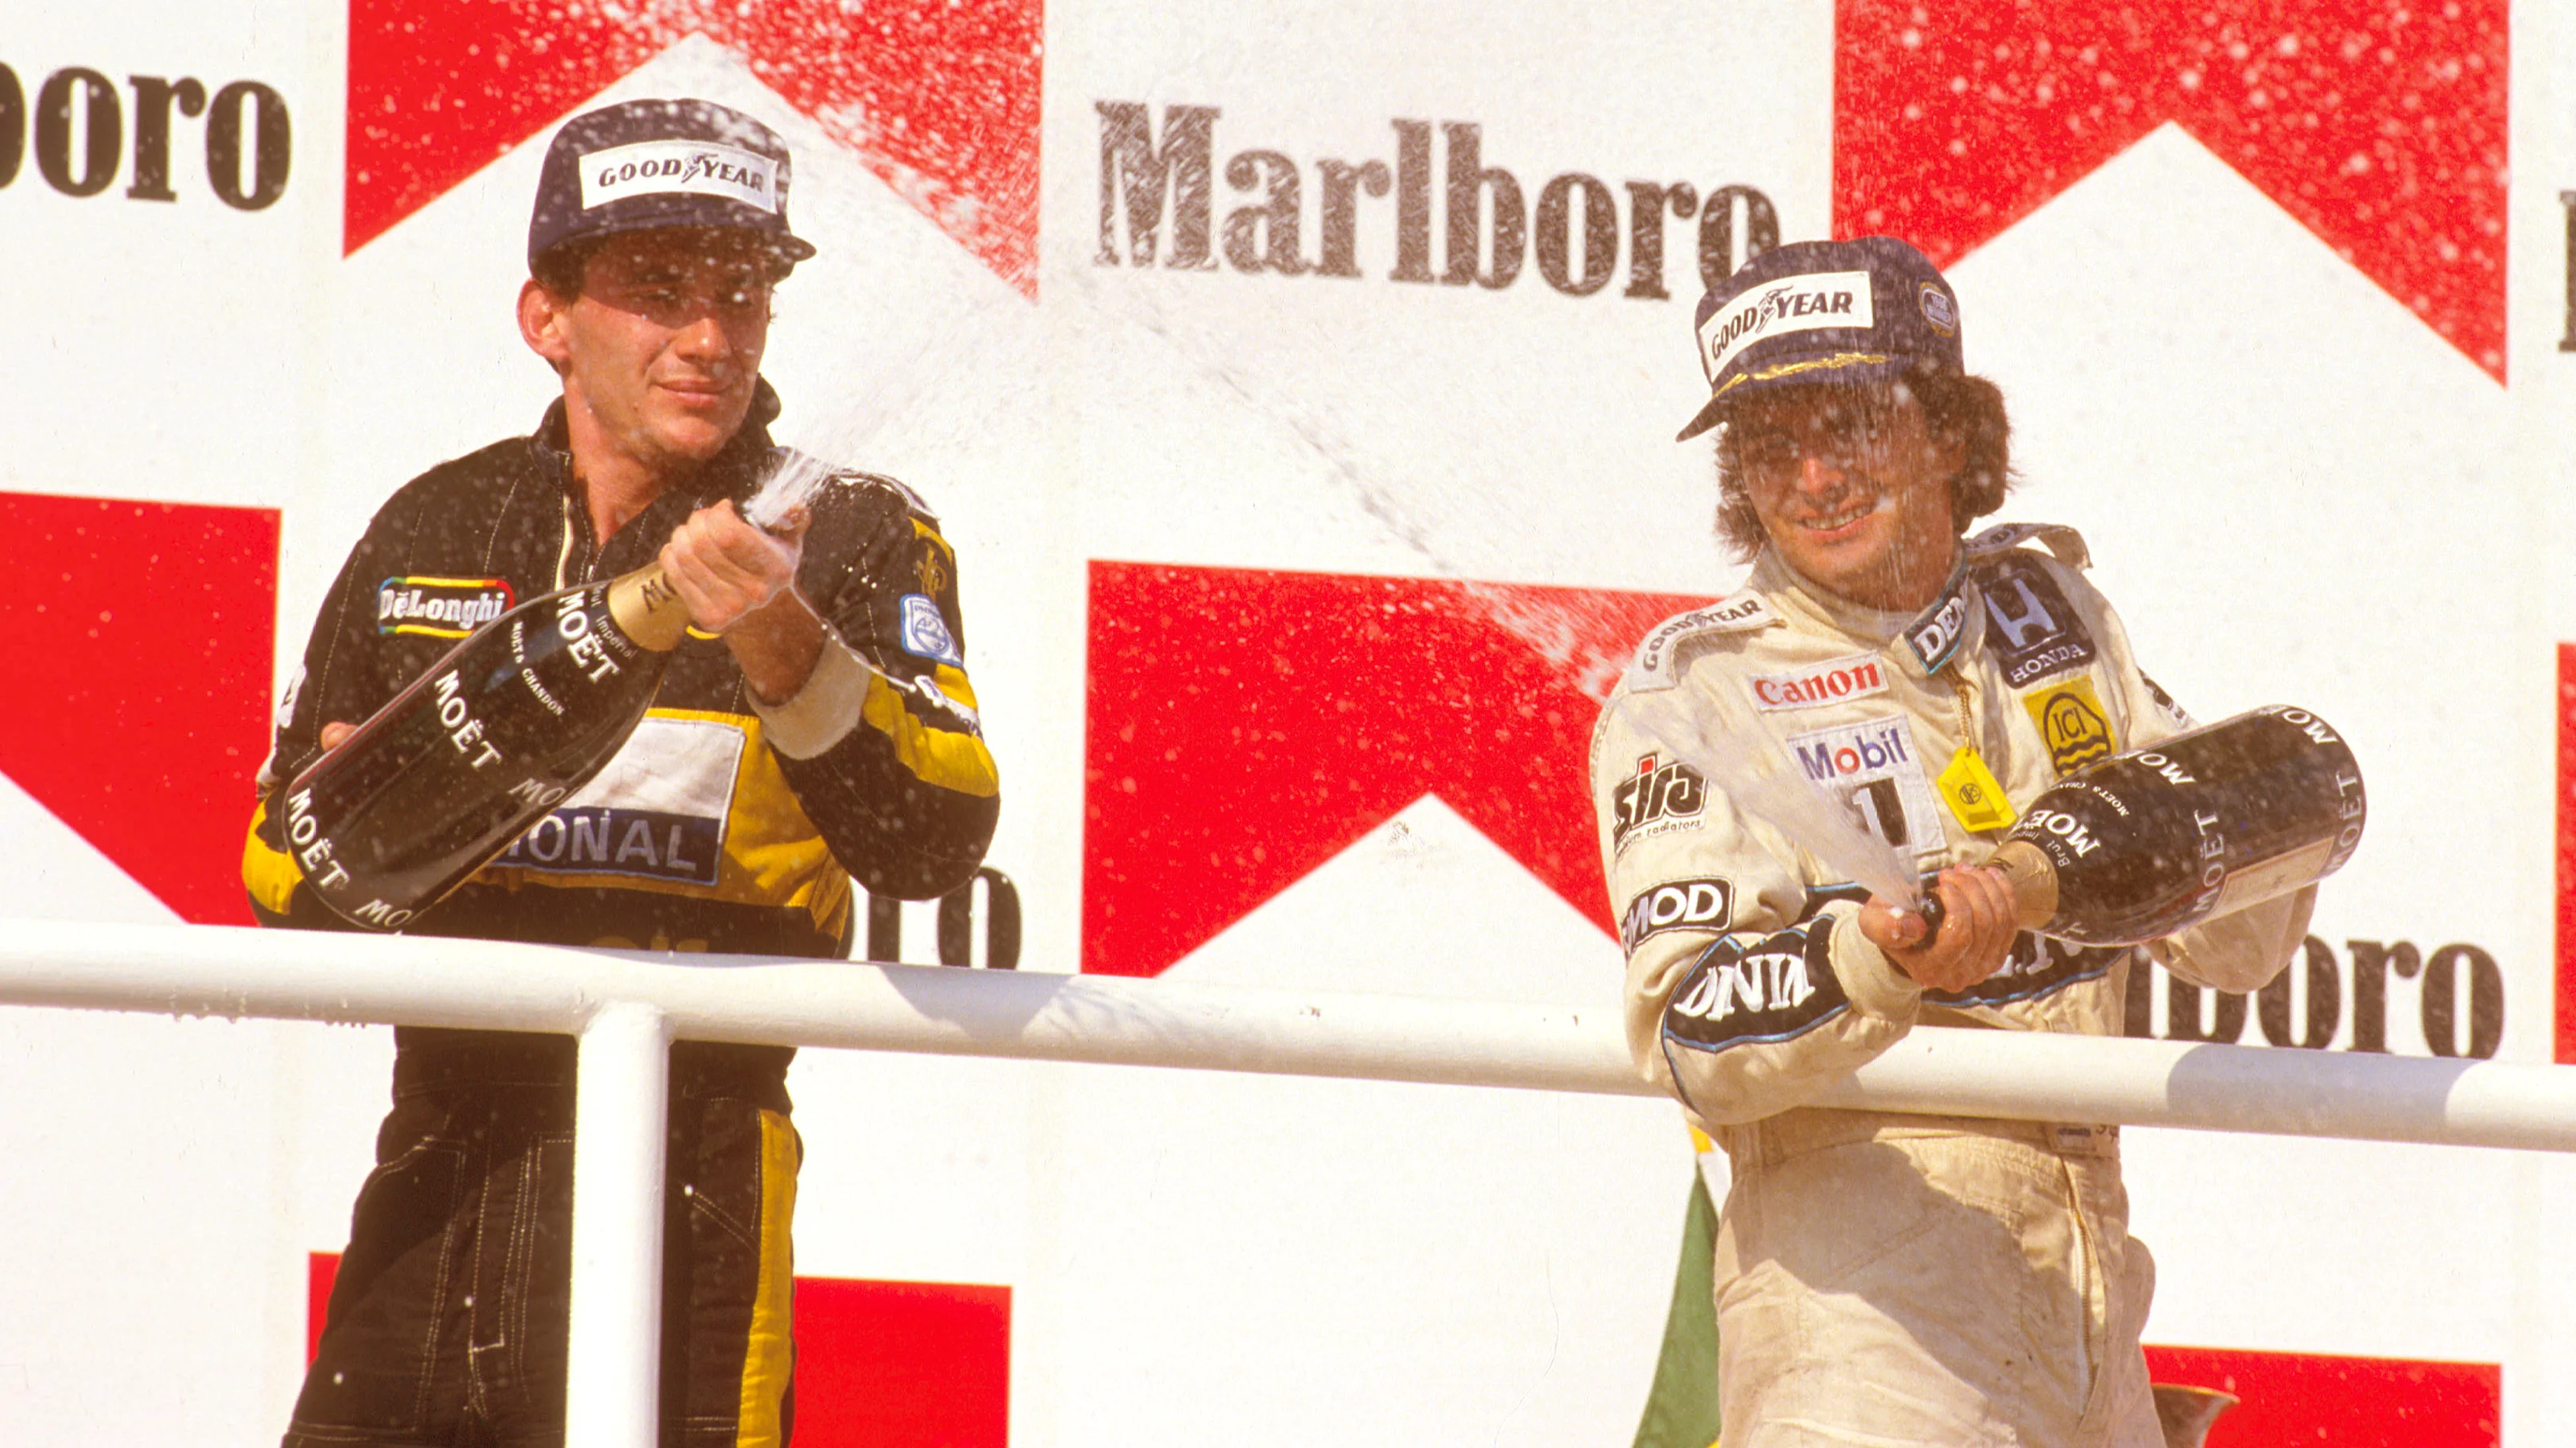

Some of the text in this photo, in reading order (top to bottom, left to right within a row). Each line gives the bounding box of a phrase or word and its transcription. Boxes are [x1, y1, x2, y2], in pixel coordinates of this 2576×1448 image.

[1093, 99, 1781, 300] Marlboro
[1754, 662, 1881, 706] Canon
[2010, 642, 2088, 683] HONDA
[522, 667, 565, 716] CHANDON
[435, 669, 503, 773] MOËT
[2051, 707, 2088, 742] ICI
[1796, 728, 1909, 781] Mobil
[288, 786, 351, 889] MOËT
[1646, 819, 1702, 839] radiators
